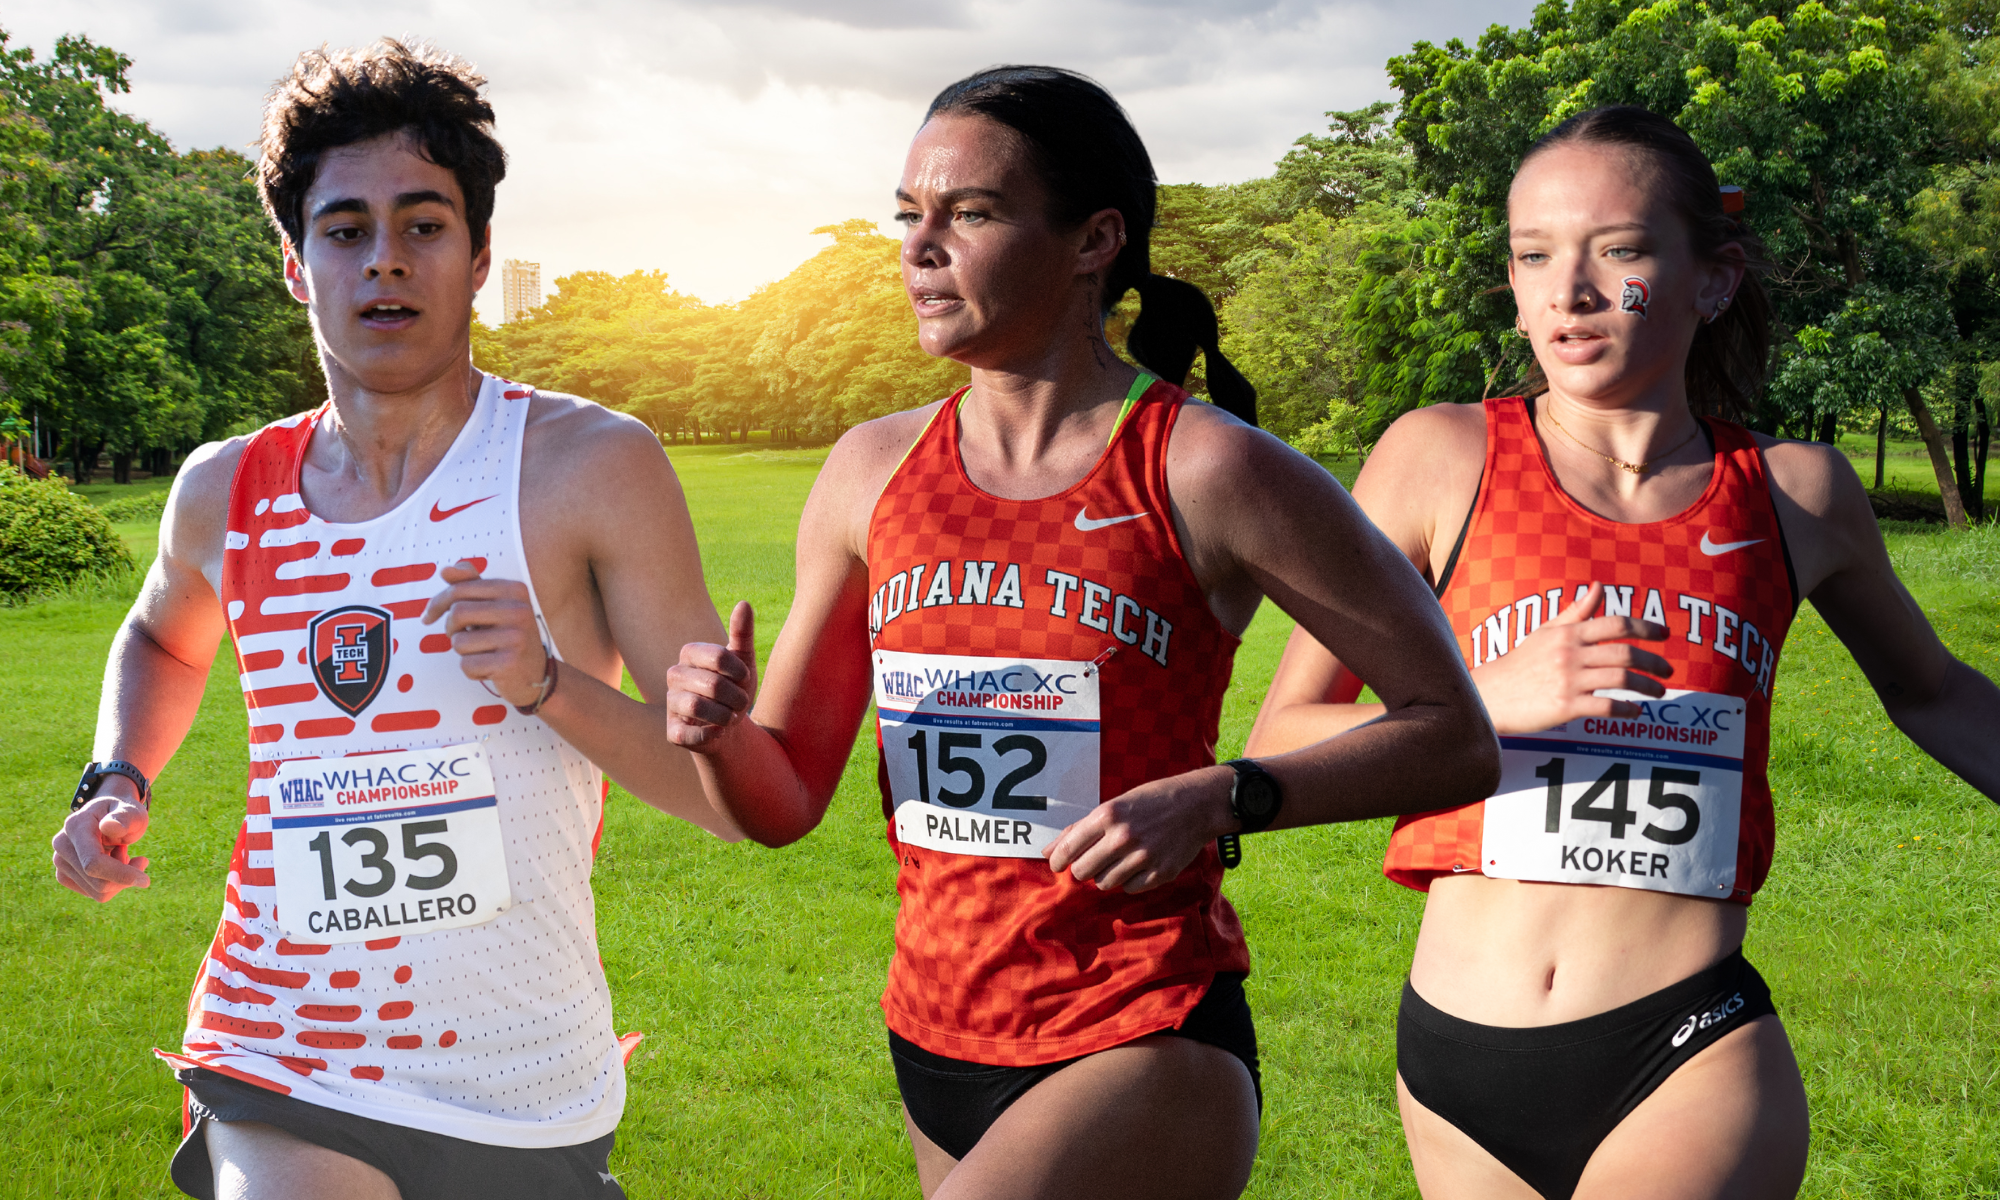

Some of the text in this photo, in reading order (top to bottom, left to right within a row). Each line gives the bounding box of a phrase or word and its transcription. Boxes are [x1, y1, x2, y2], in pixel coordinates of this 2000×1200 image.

[1045, 569, 1173, 668] TECH
[336, 648, 364, 659] TECH
[1678, 593, 1774, 699] TECH
[882, 670, 924, 698] WHAC
[924, 667, 1077, 694] WHAC XC
[937, 690, 1064, 711] CHAMPIONSHIP
[972, 719, 1014, 728] fatresults.com
[1633, 701, 1731, 731] AC XC
[1583, 718, 1718, 746] CHAMPIONSHIP
[1623, 749, 1669, 759] fatresults.com
[322, 757, 470, 790] WHAC XC
[907, 729, 1047, 811] 152
[279, 777, 324, 804] WHAC
[336, 780, 459, 805] CHAMPIONSHIP
[1535, 757, 1700, 845] 145
[346, 814, 366, 822] results
[373, 810, 416, 819] fatresults.com
[926, 814, 1032, 845] PALMER
[308, 818, 458, 901] 135
[1560, 845, 1670, 879] KOKER
[308, 893, 477, 934] CABALLERO
